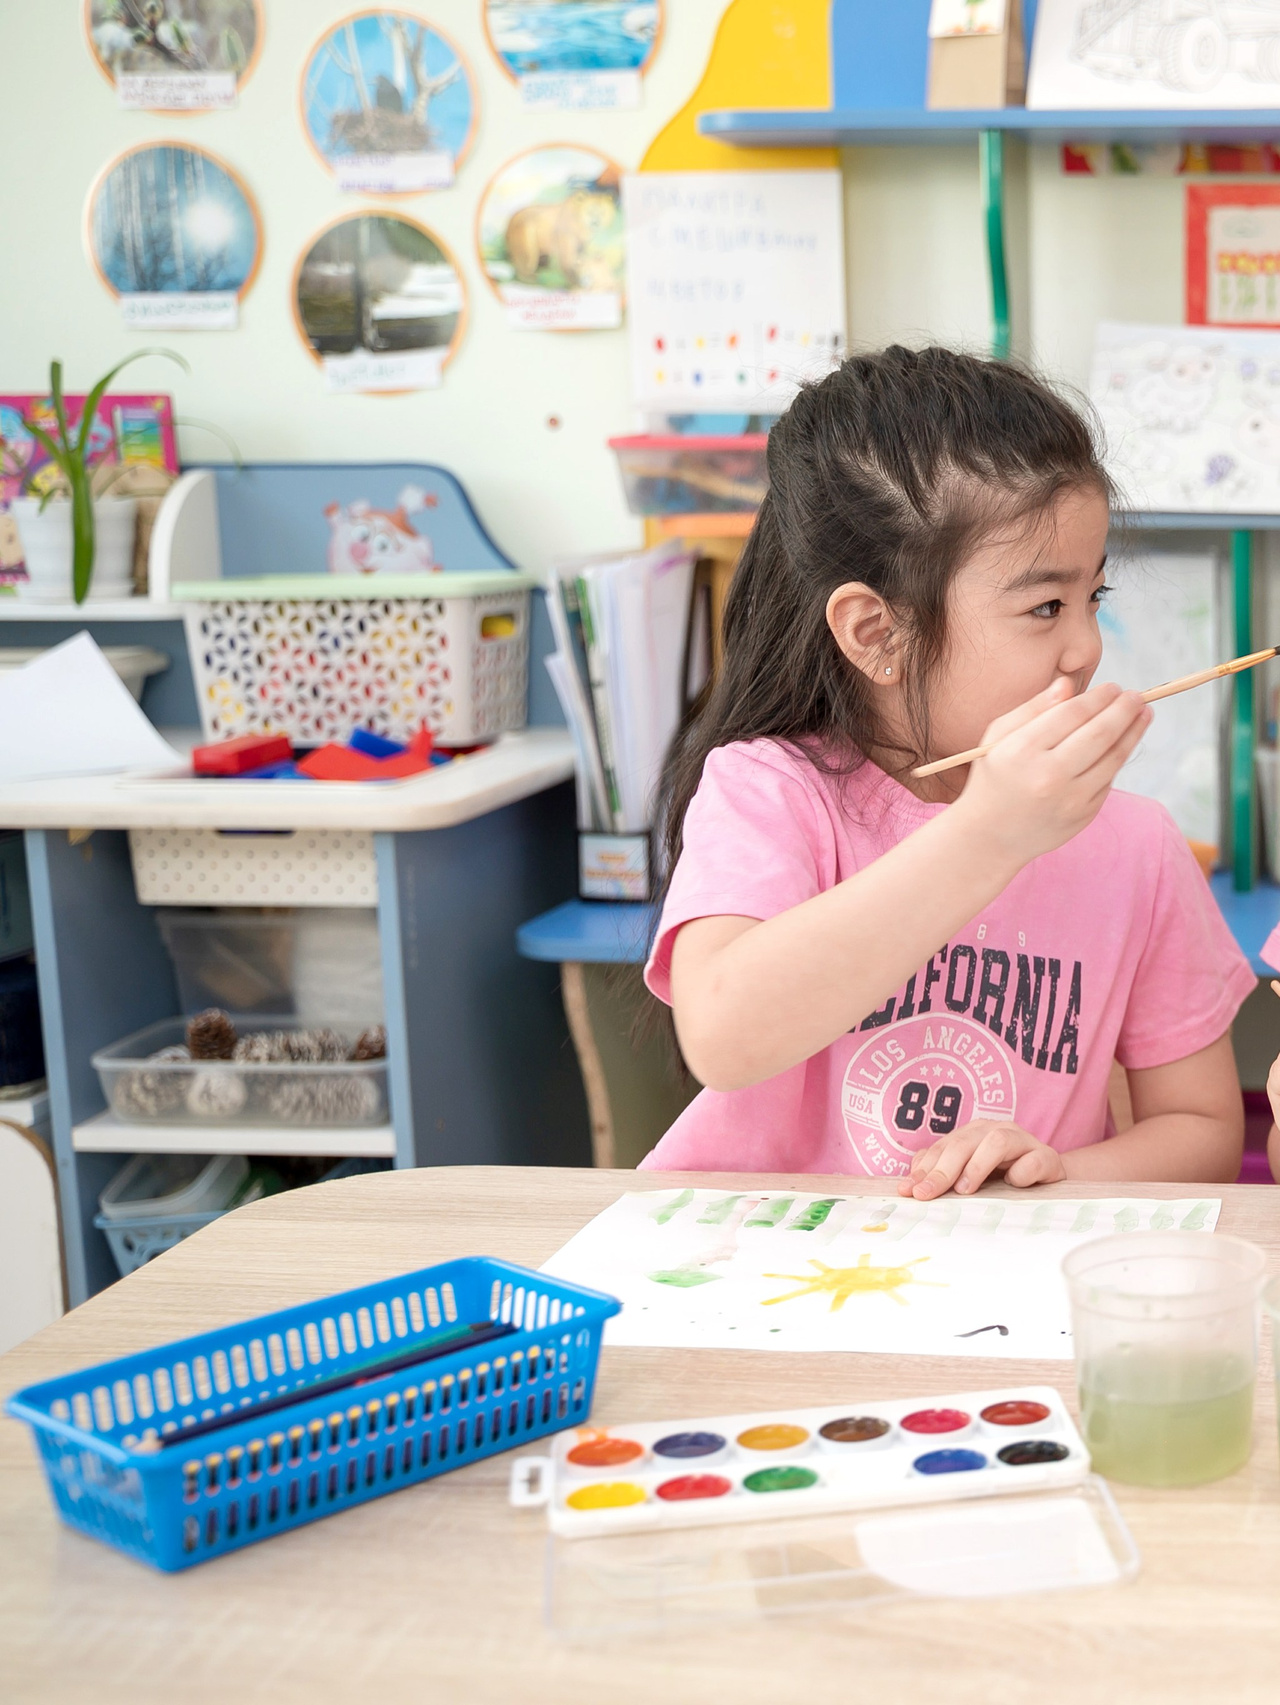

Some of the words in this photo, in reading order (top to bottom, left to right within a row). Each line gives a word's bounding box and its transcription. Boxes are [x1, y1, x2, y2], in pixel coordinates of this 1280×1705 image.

[846, 943, 1082, 1074] IFORNIA
[859, 1039, 906, 1085] LOS
[922, 1025, 1005, 1105] ANGELES
[848, 1092, 873, 1115] USA
[893, 1080, 963, 1135] 89
[862, 1133, 910, 1176] WEST
